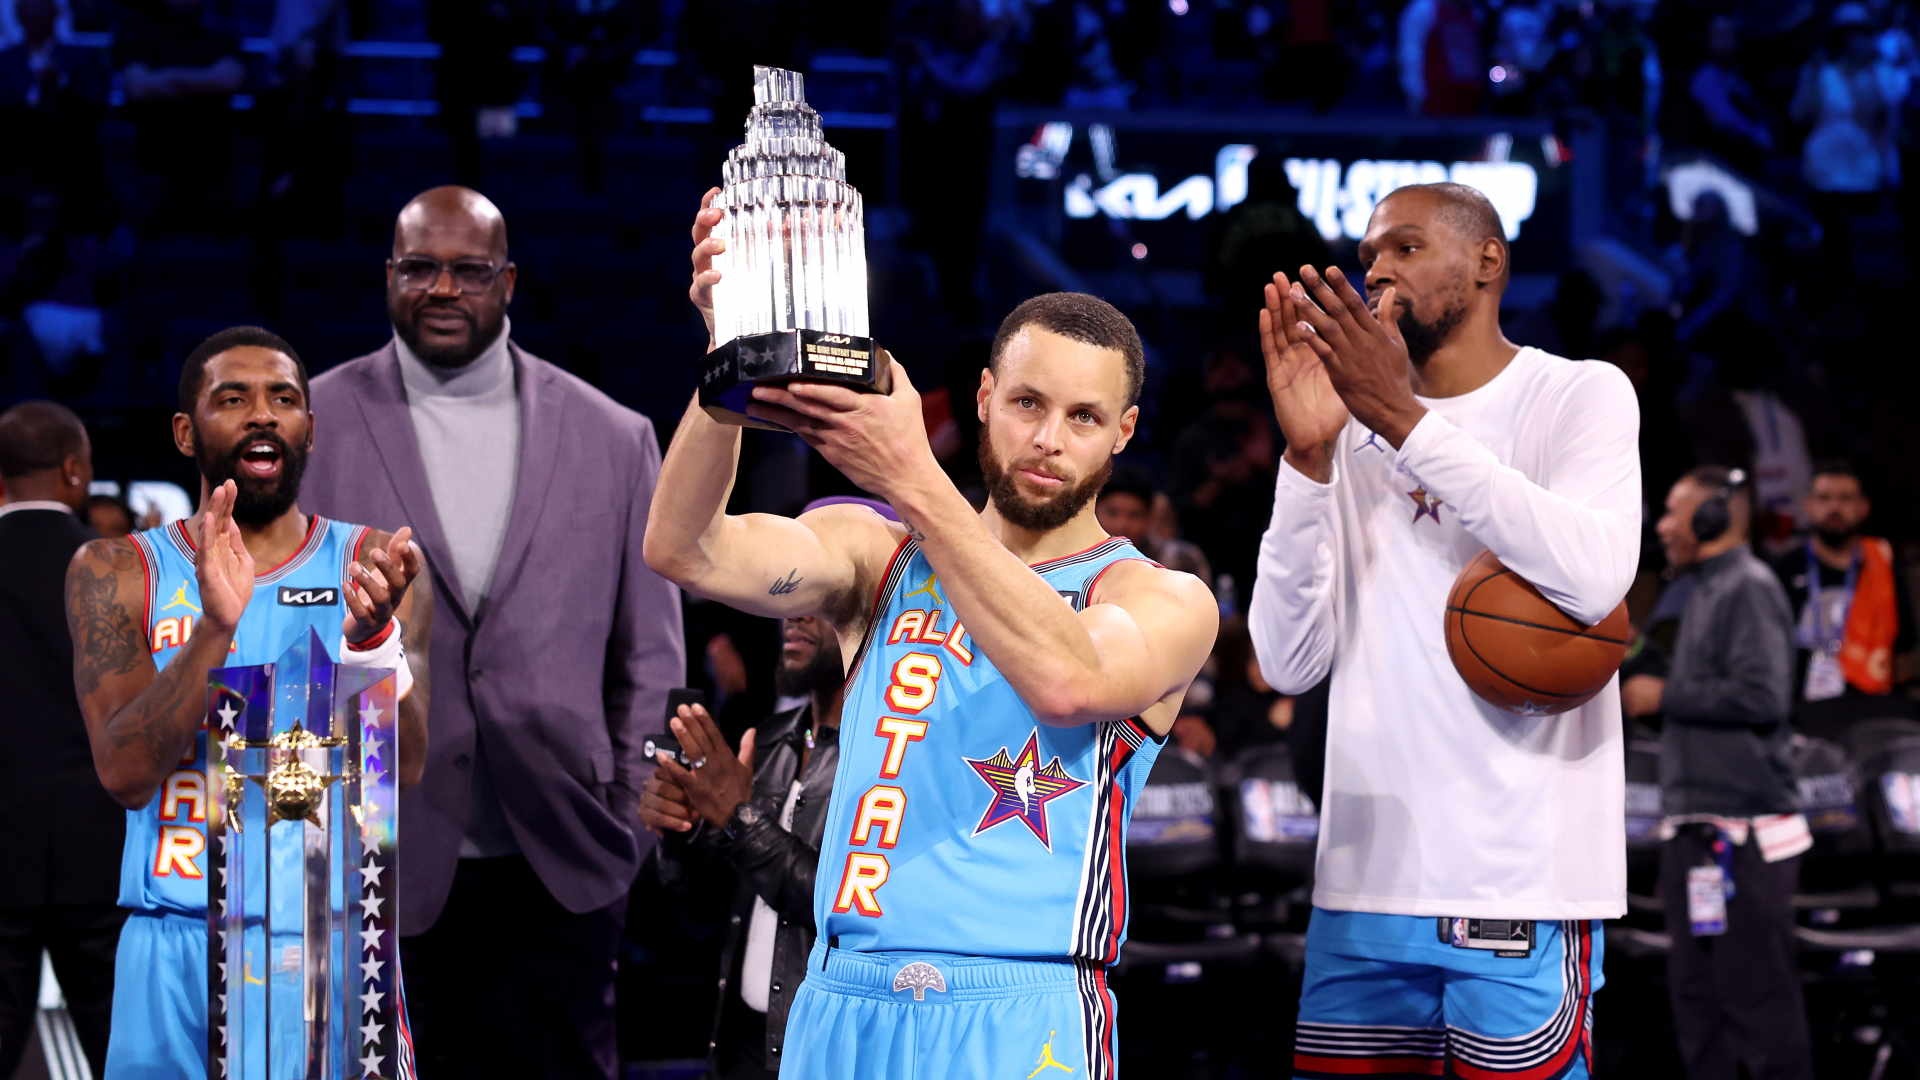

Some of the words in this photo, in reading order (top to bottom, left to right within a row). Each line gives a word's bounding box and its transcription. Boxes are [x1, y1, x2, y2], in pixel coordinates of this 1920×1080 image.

[283, 590, 333, 603] KIA
[152, 615, 236, 653] AL
[887, 609, 974, 667] ALL
[832, 652, 942, 918] STAR
